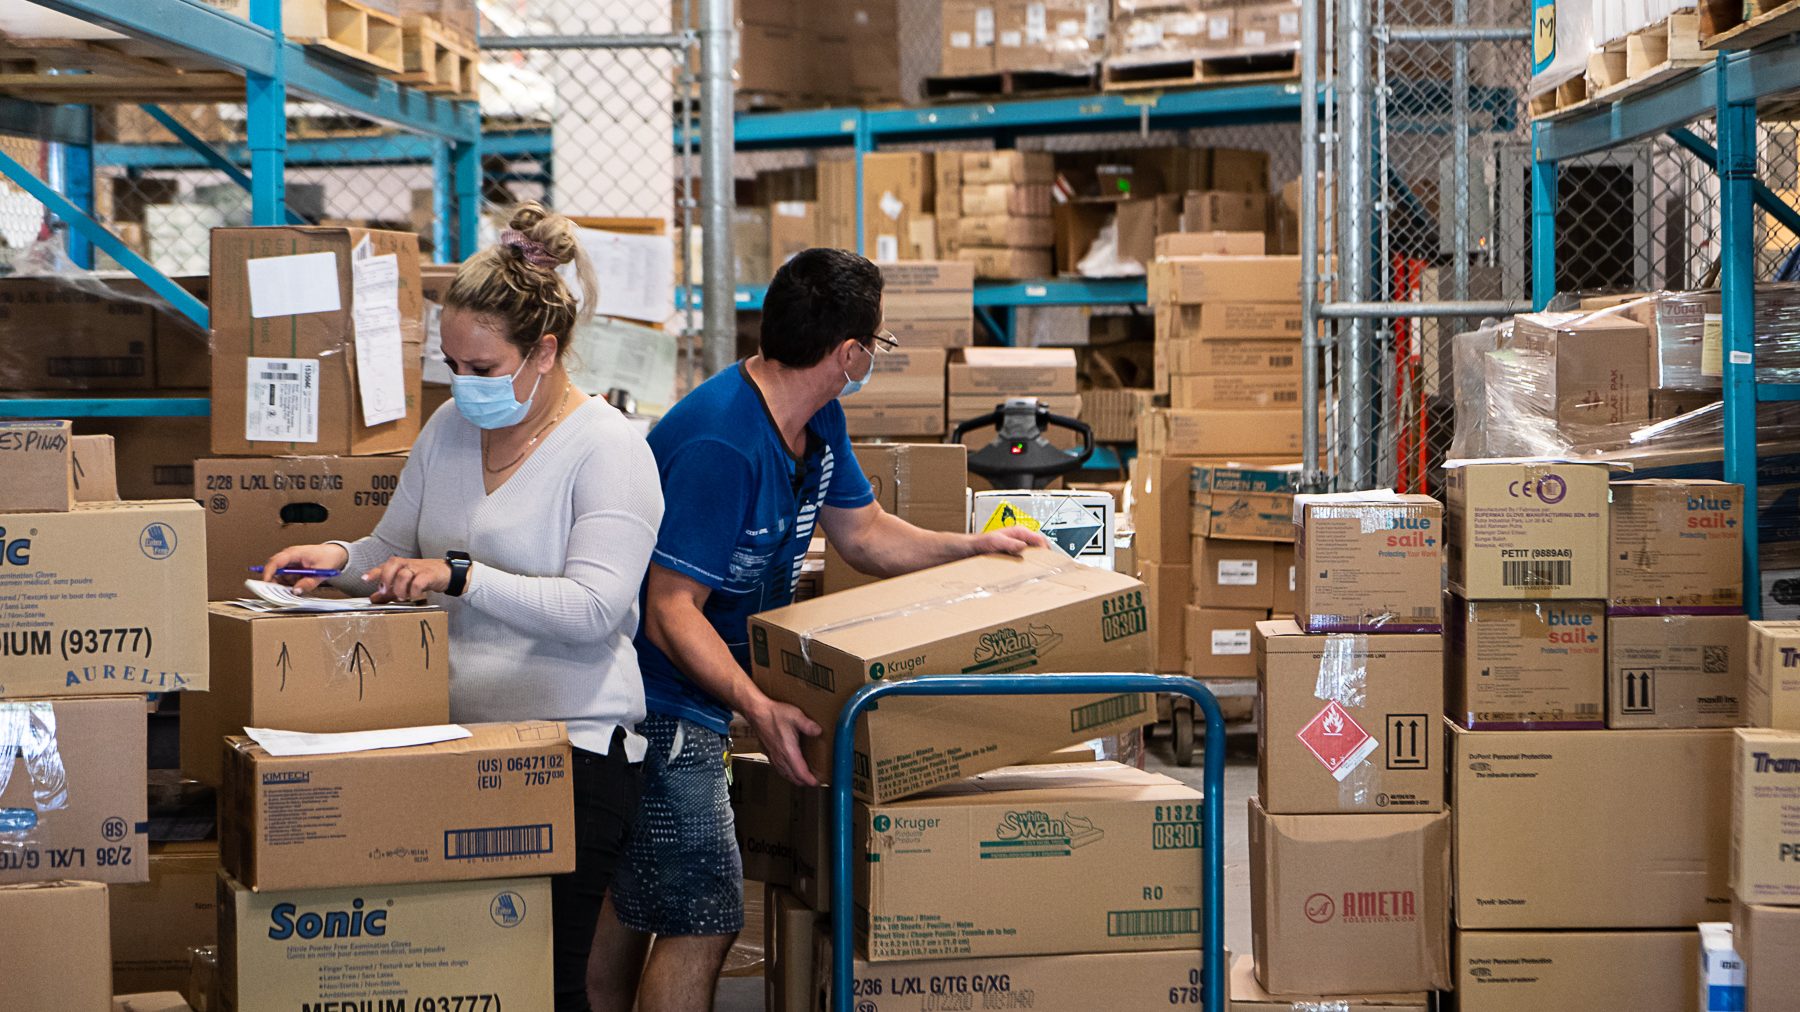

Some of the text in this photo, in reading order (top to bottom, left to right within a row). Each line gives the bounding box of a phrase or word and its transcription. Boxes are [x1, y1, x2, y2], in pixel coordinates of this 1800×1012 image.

[1539, 18, 1553, 38] M
[206, 474, 232, 491] 2/28
[240, 474, 269, 491] L/XL
[1508, 480, 1533, 498] CE
[213, 498, 226, 510] SB
[1687, 495, 1731, 511] blue
[1501, 549, 1529, 557] PETIT
[1103, 590, 1142, 615] 61328
[1103, 608, 1145, 641] 08301
[1548, 609, 1592, 626] blue
[0, 627, 152, 660] IUM (93777)
[974, 632, 1032, 663] Swan
[887, 655, 927, 673] Kruger
[66, 664, 189, 687] AURELIA
[478, 758, 502, 774] (US)
[1330, 757, 1336, 766] 3
[263, 771, 310, 782] KIMTECH
[478, 775, 502, 791] (EU)
[895, 817, 941, 832] Kruger
[996, 810, 1065, 840] Swan
[1016, 811, 1049, 821] white
[106, 821, 123, 837] SB
[45, 847, 86, 868] L/XL
[96, 847, 131, 866] 2/36
[1342, 891, 1416, 917] AMETA
[268, 898, 388, 941] Sonic
[853, 974, 1010, 998] 2/36 L/XL G/TG G/XG
[1169, 986, 1204, 1005] 678
